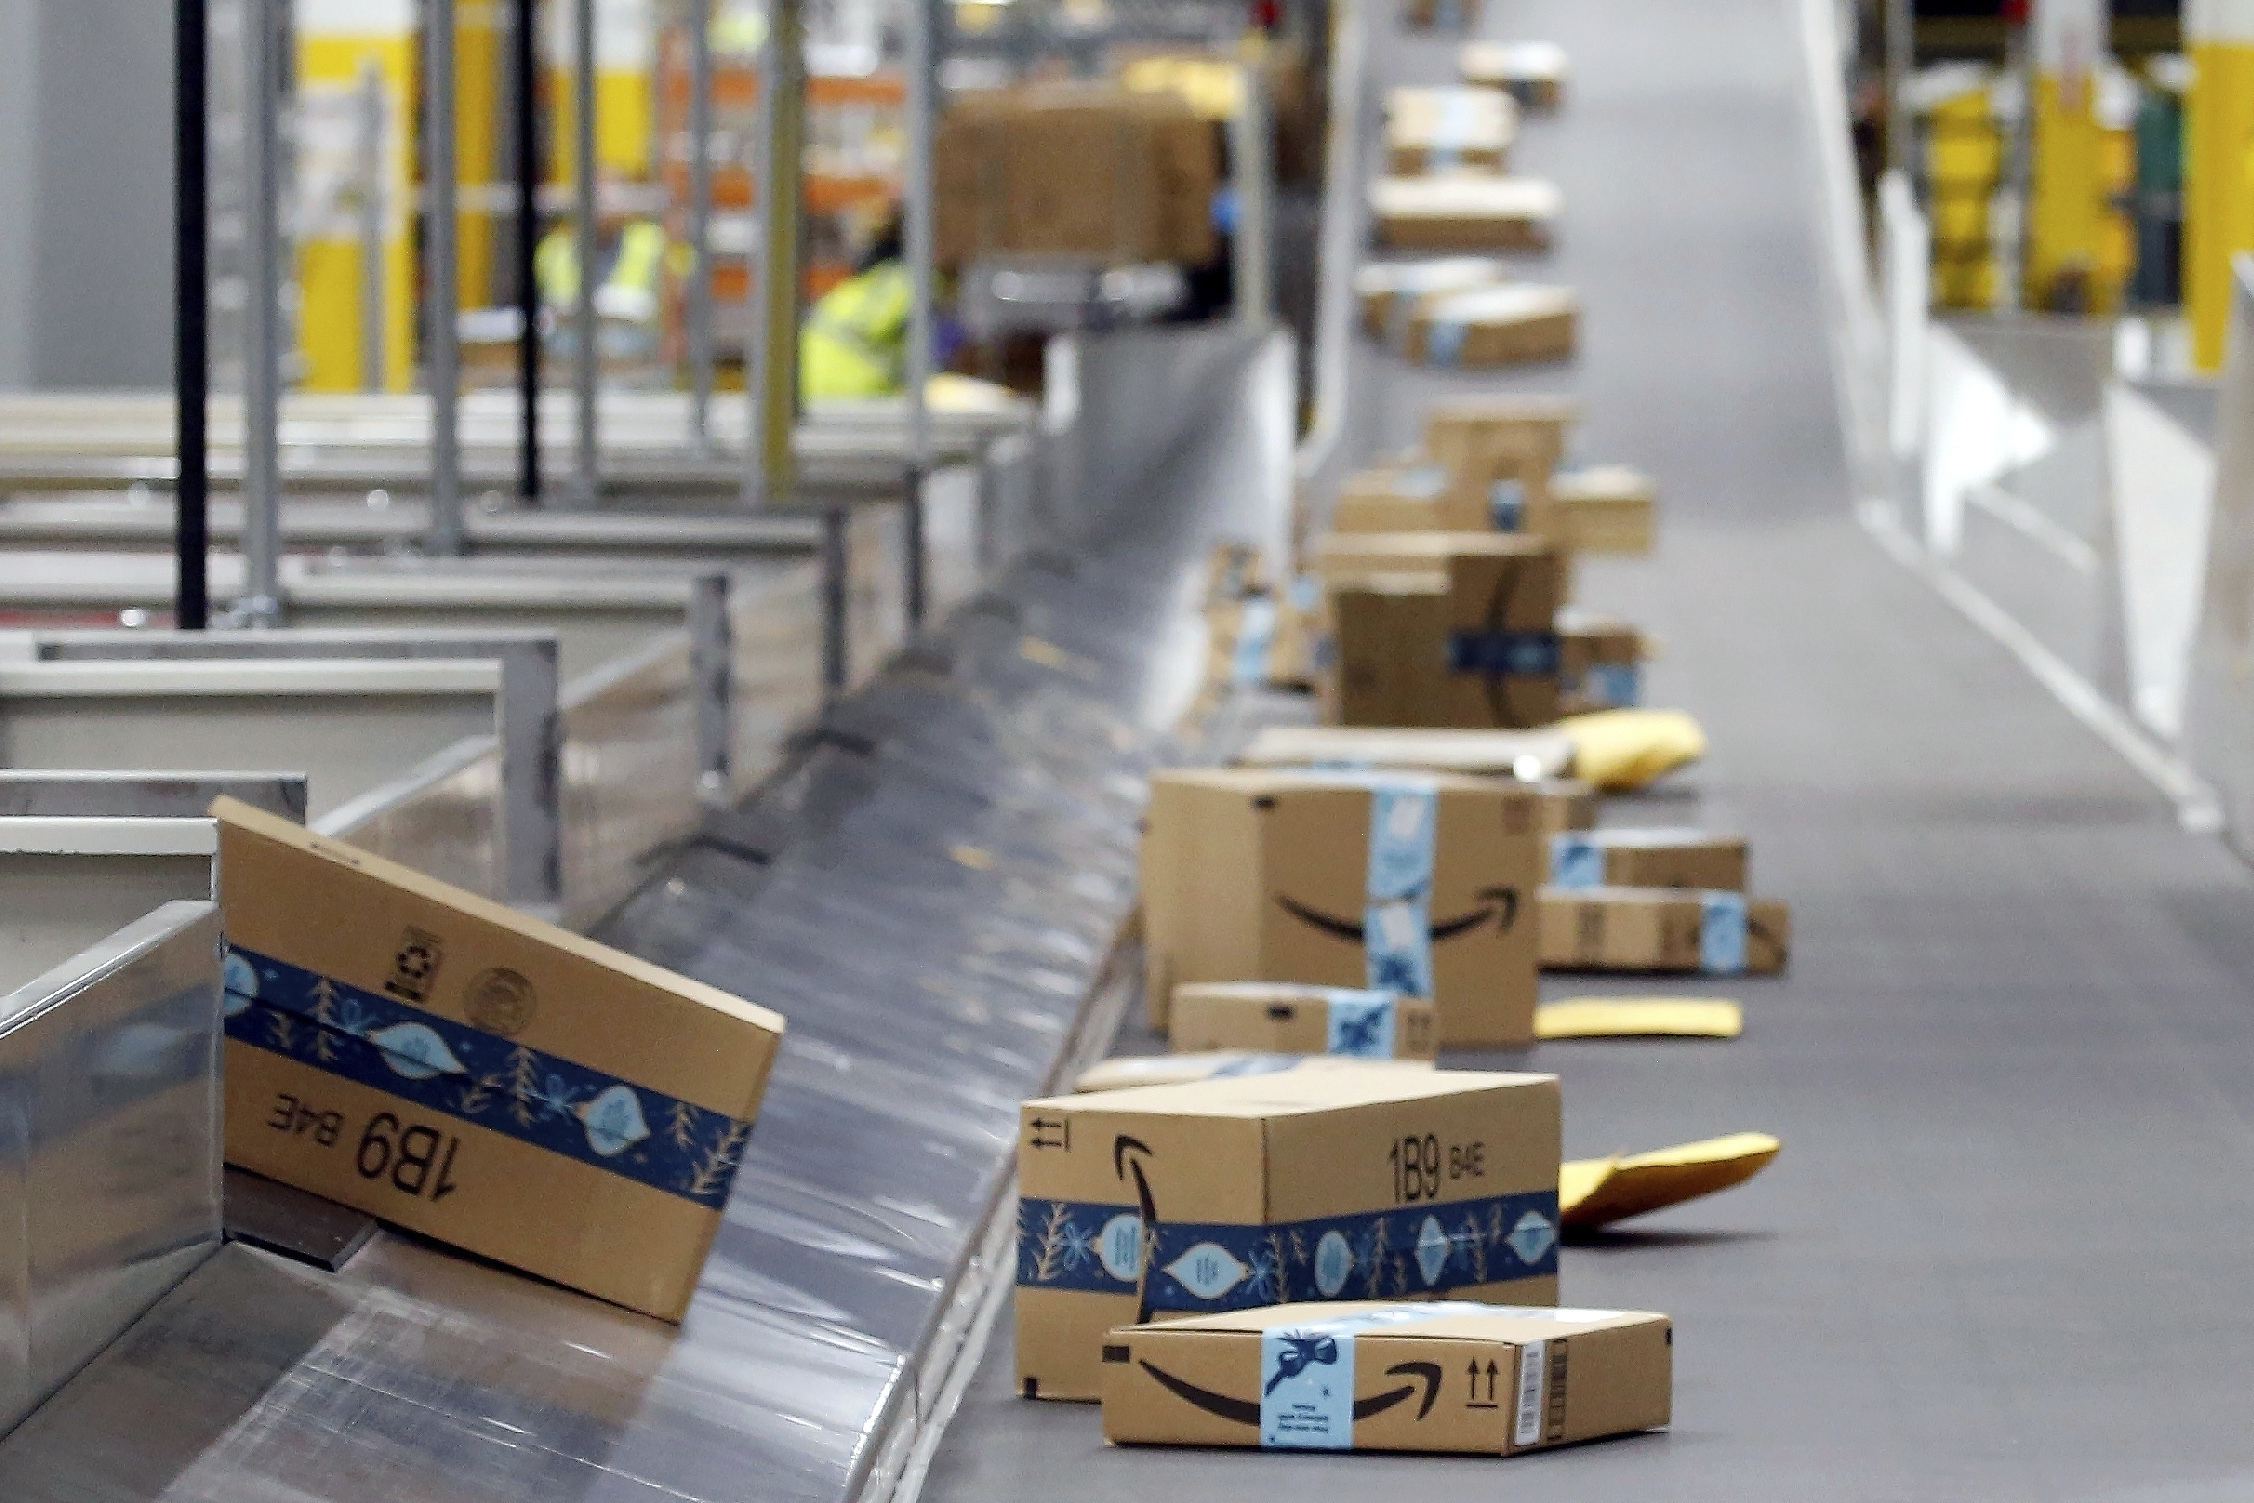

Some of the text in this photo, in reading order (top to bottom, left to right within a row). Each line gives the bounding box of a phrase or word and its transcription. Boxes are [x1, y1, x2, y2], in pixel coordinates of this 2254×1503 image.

[267, 1092, 461, 1203] 1B9 B4E
[1387, 1133, 1485, 1202] 1B9 B4E
